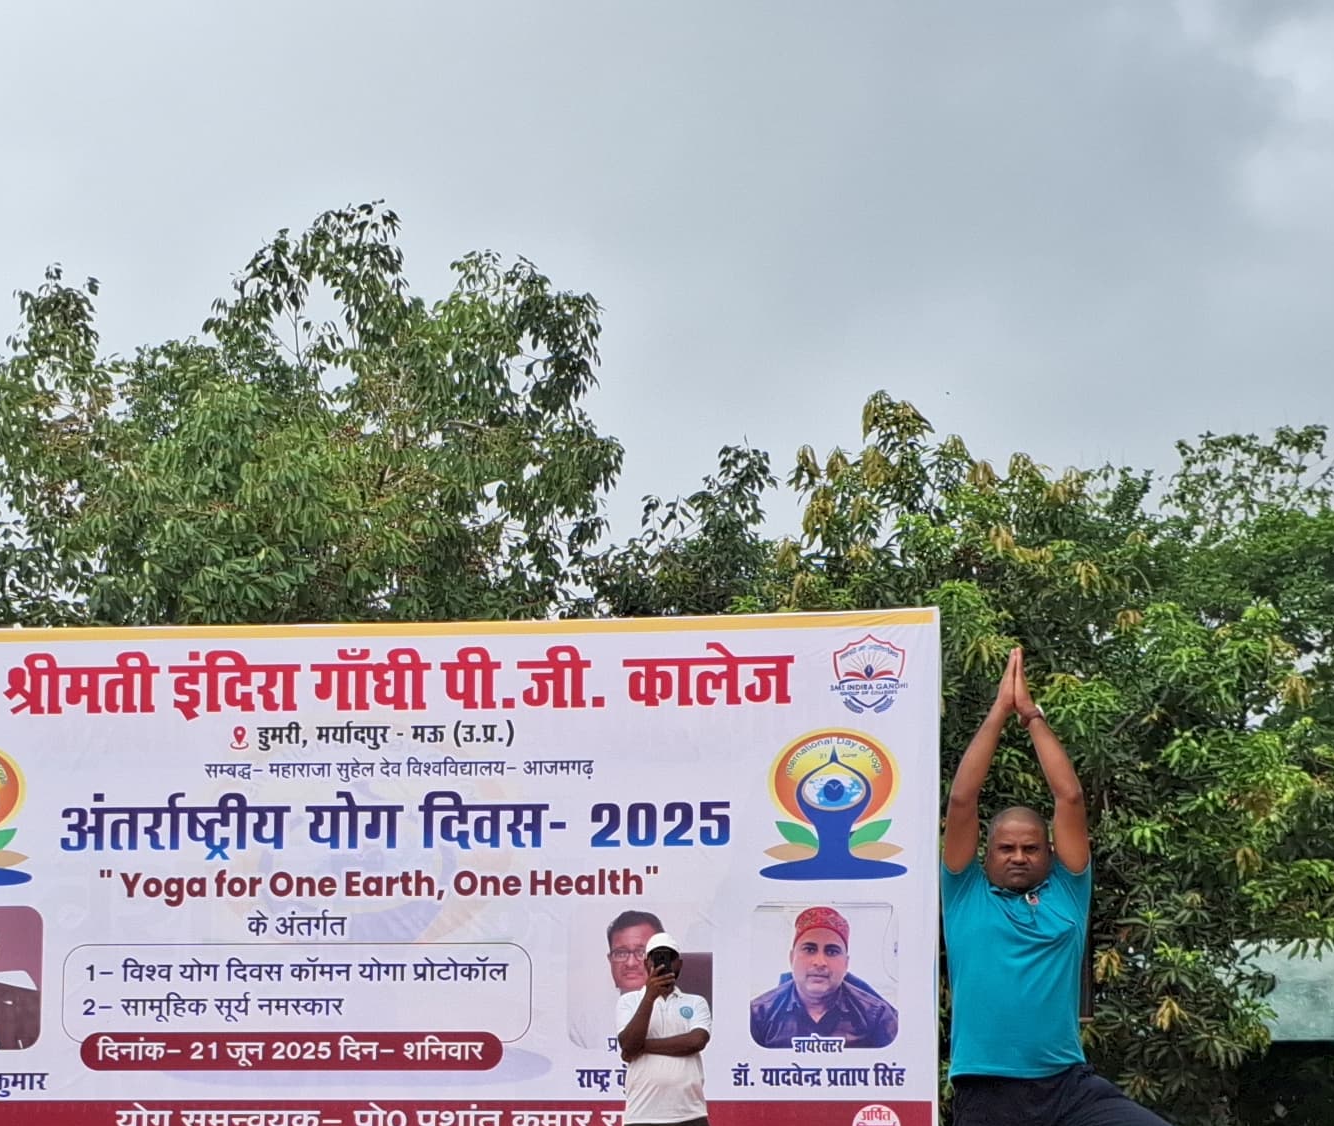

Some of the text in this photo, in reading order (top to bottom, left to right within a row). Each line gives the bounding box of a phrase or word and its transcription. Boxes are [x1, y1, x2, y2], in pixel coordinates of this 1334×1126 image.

[3, 652, 160, 715] श्रीमती
[169, 650, 301, 721] इंदिरा
[623, 642, 795, 707] कालेज
[316, 721, 391, 751] मर्यादपुर
[411, 725, 446, 743] मऊ
[269, 763, 331, 778] महाराजा
[337, 757, 374, 783] सुहेल
[379, 757, 402, 777] देव
[305, 791, 404, 850] योग
[590, 801, 731, 848] 2025
[214, 869, 262, 898] for
[269, 871, 337, 898] One
[344, 869, 445, 901] Earth,
[453, 870, 522, 896] One
[248, 910, 347, 937] के अंतर्गत
[121, 958, 174, 982] विश्व
[178, 957, 220, 982] योग
[225, 957, 284, 982] दिवस
[289, 957, 353, 982] कॉमन
[358, 957, 407, 981] योगा
[412, 956, 509, 981] प्रोटोकॉल
[120, 991, 208, 1022] सामूहिक
[213, 991, 251, 1023] सूर्य
[256, 998, 345, 1016] नमस्कार
[189, 1041, 218, 1060] 21
[225, 1041, 266, 1067] जून
[271, 1041, 332, 1060] 2025
[402, 1034, 485, 1061] शनिवार
[826, 1067, 870, 1088] प्रताप
[873, 1062, 906, 1087] सिंह
